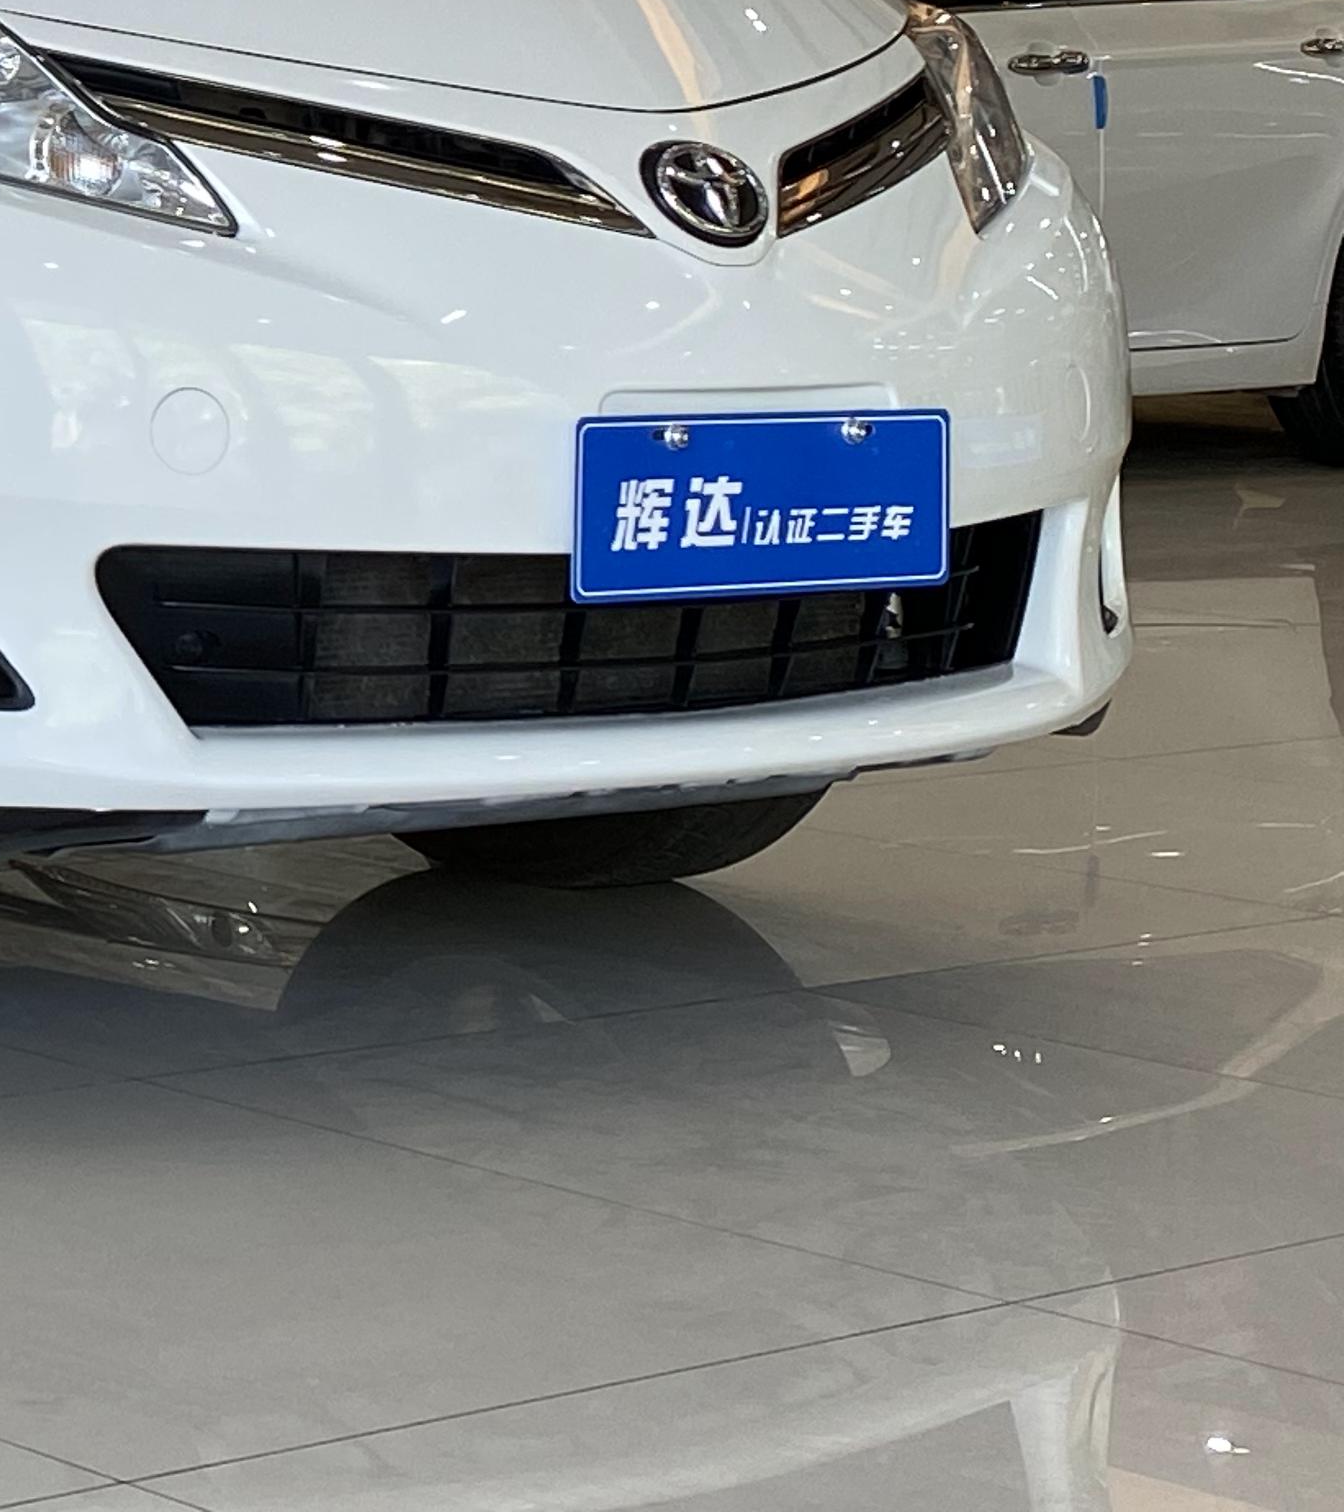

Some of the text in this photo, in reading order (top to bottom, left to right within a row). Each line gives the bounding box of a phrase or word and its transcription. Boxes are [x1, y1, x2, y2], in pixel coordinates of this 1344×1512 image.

[611, 476, 914, 551] 辉达 认证二手车
